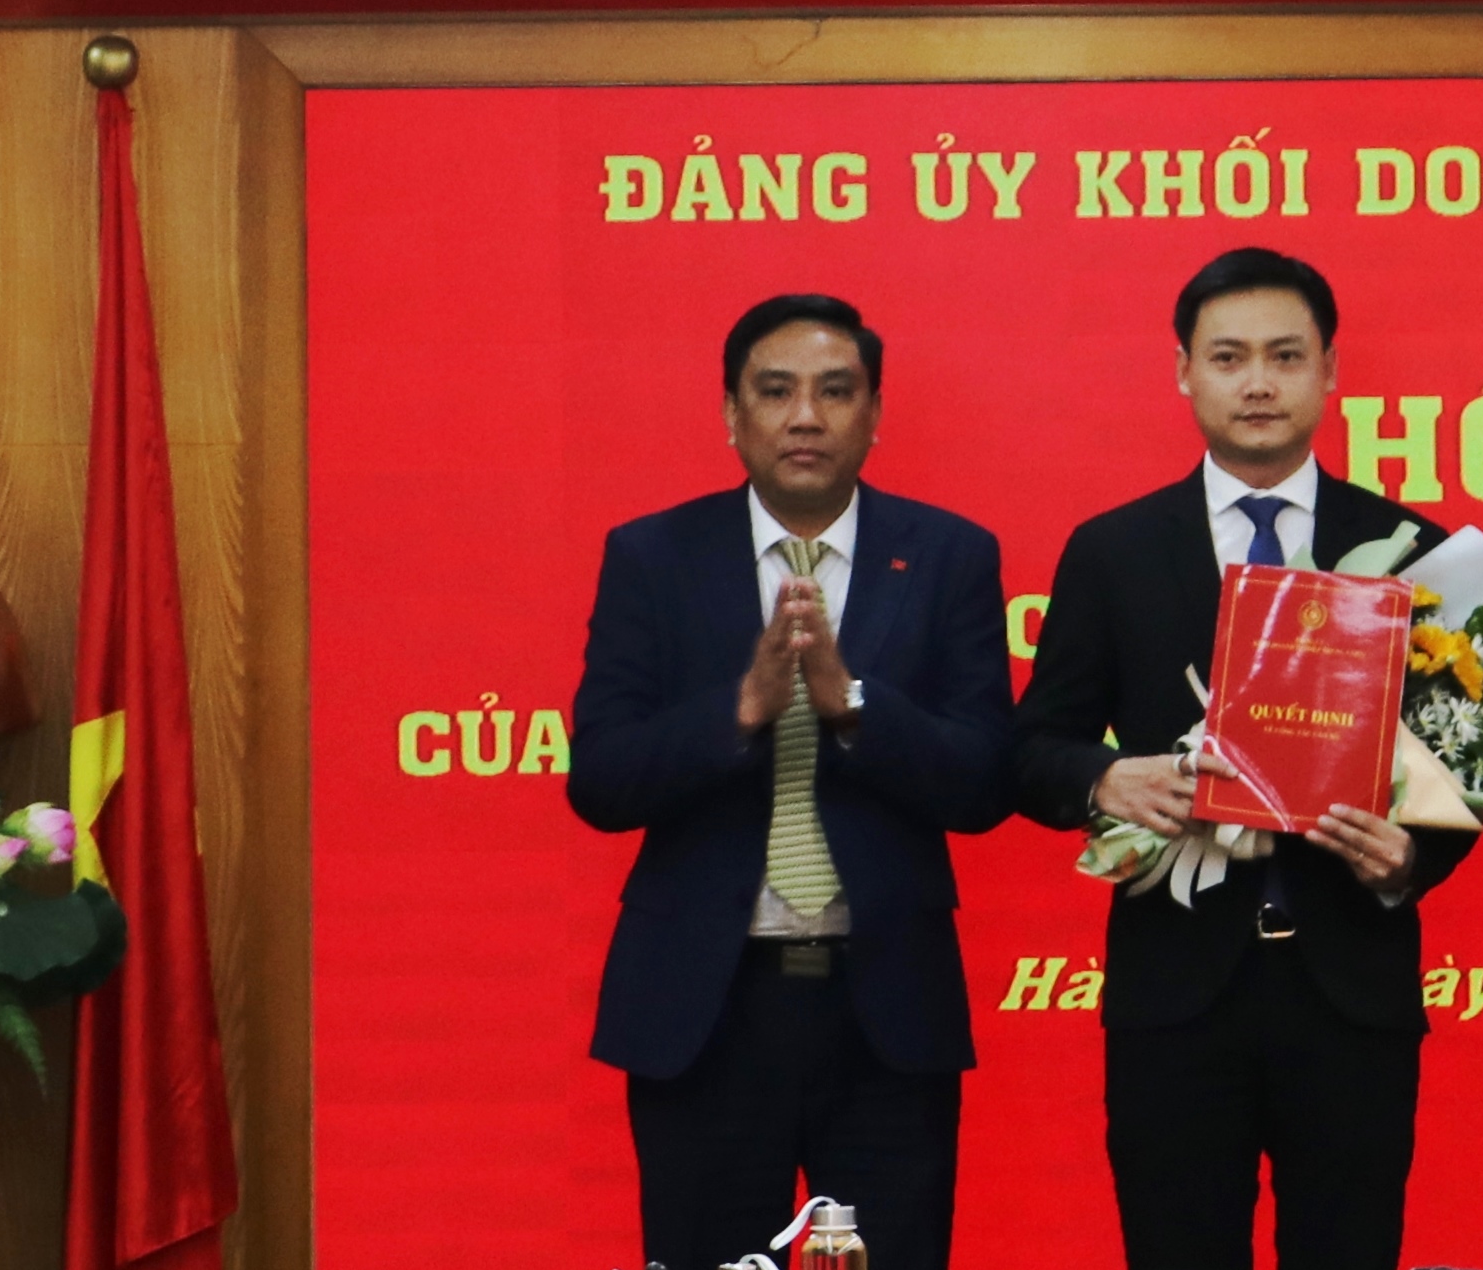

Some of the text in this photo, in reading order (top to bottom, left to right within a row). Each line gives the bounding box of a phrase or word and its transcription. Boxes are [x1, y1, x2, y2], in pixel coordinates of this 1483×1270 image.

[600, 134, 867, 222] ĐẢNG
[912, 133, 1036, 220] ỦY
[1075, 127, 1308, 217] KHỐI
[398, 691, 571, 777] CỦA
[1249, 702, 1355, 728] QUYẾT ĐỊNH
[999, 954, 1105, 1011] Hà
